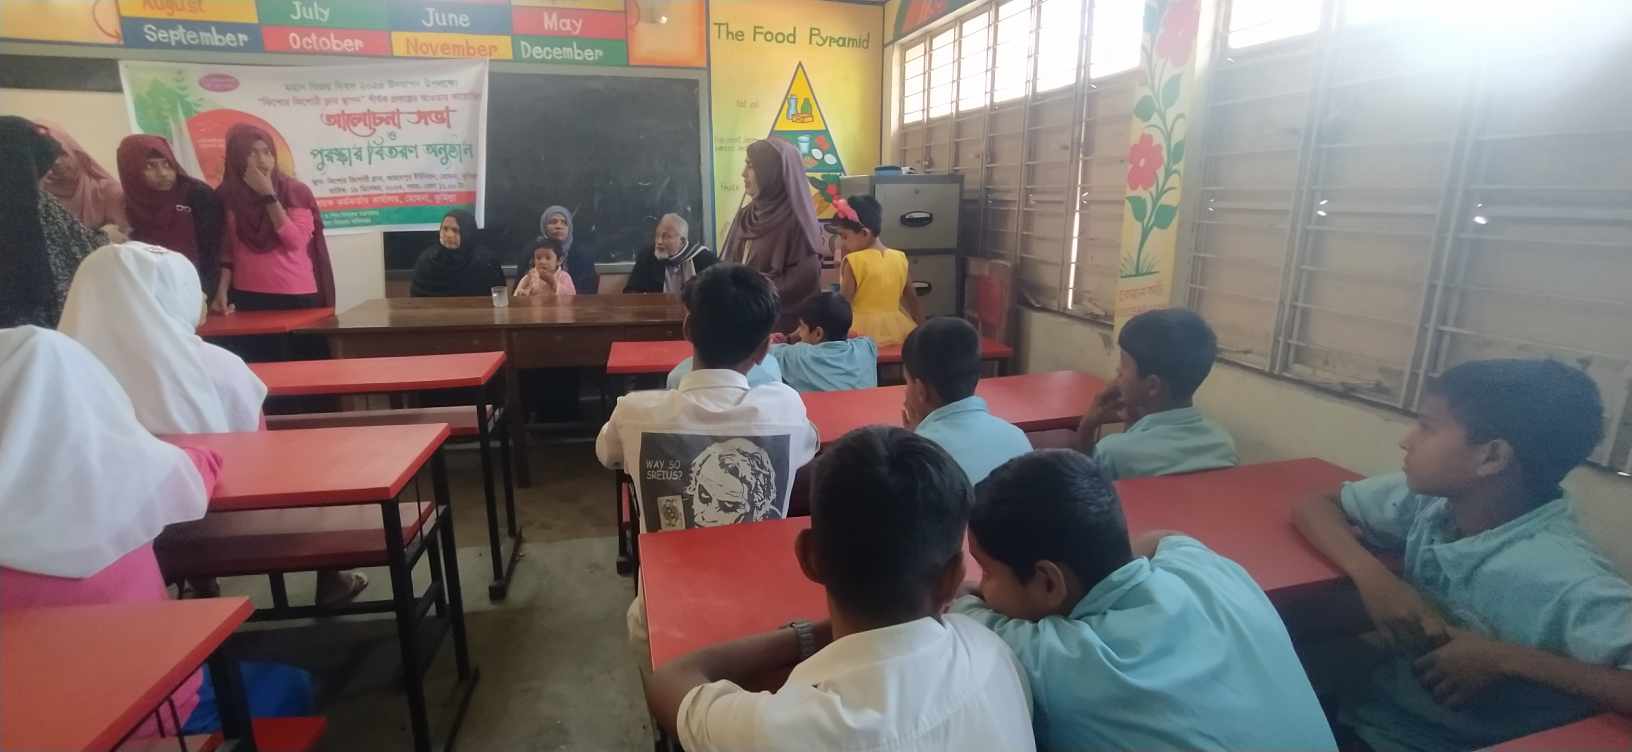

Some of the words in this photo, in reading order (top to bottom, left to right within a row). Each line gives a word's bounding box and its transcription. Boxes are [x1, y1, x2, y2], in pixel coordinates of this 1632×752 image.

[289, 1, 330, 22] July
[422, 7, 470, 28] June
[543, 15, 583, 33] May
[143, 24, 248, 47] September
[288, 32, 364, 52] October
[714, 22, 745, 42] The
[752, 25, 797, 44] Food
[808, 27, 871, 49] Pyramid
[405, 37, 498, 57] November
[520, 40, 603, 61] December
[320, 108, 401, 137] আলোচনা
[406, 106, 456, 128] সভা
[367, 135, 418, 165] বিতরণ
[646, 458, 664, 470] WAY
[669, 459, 680, 470] SO
